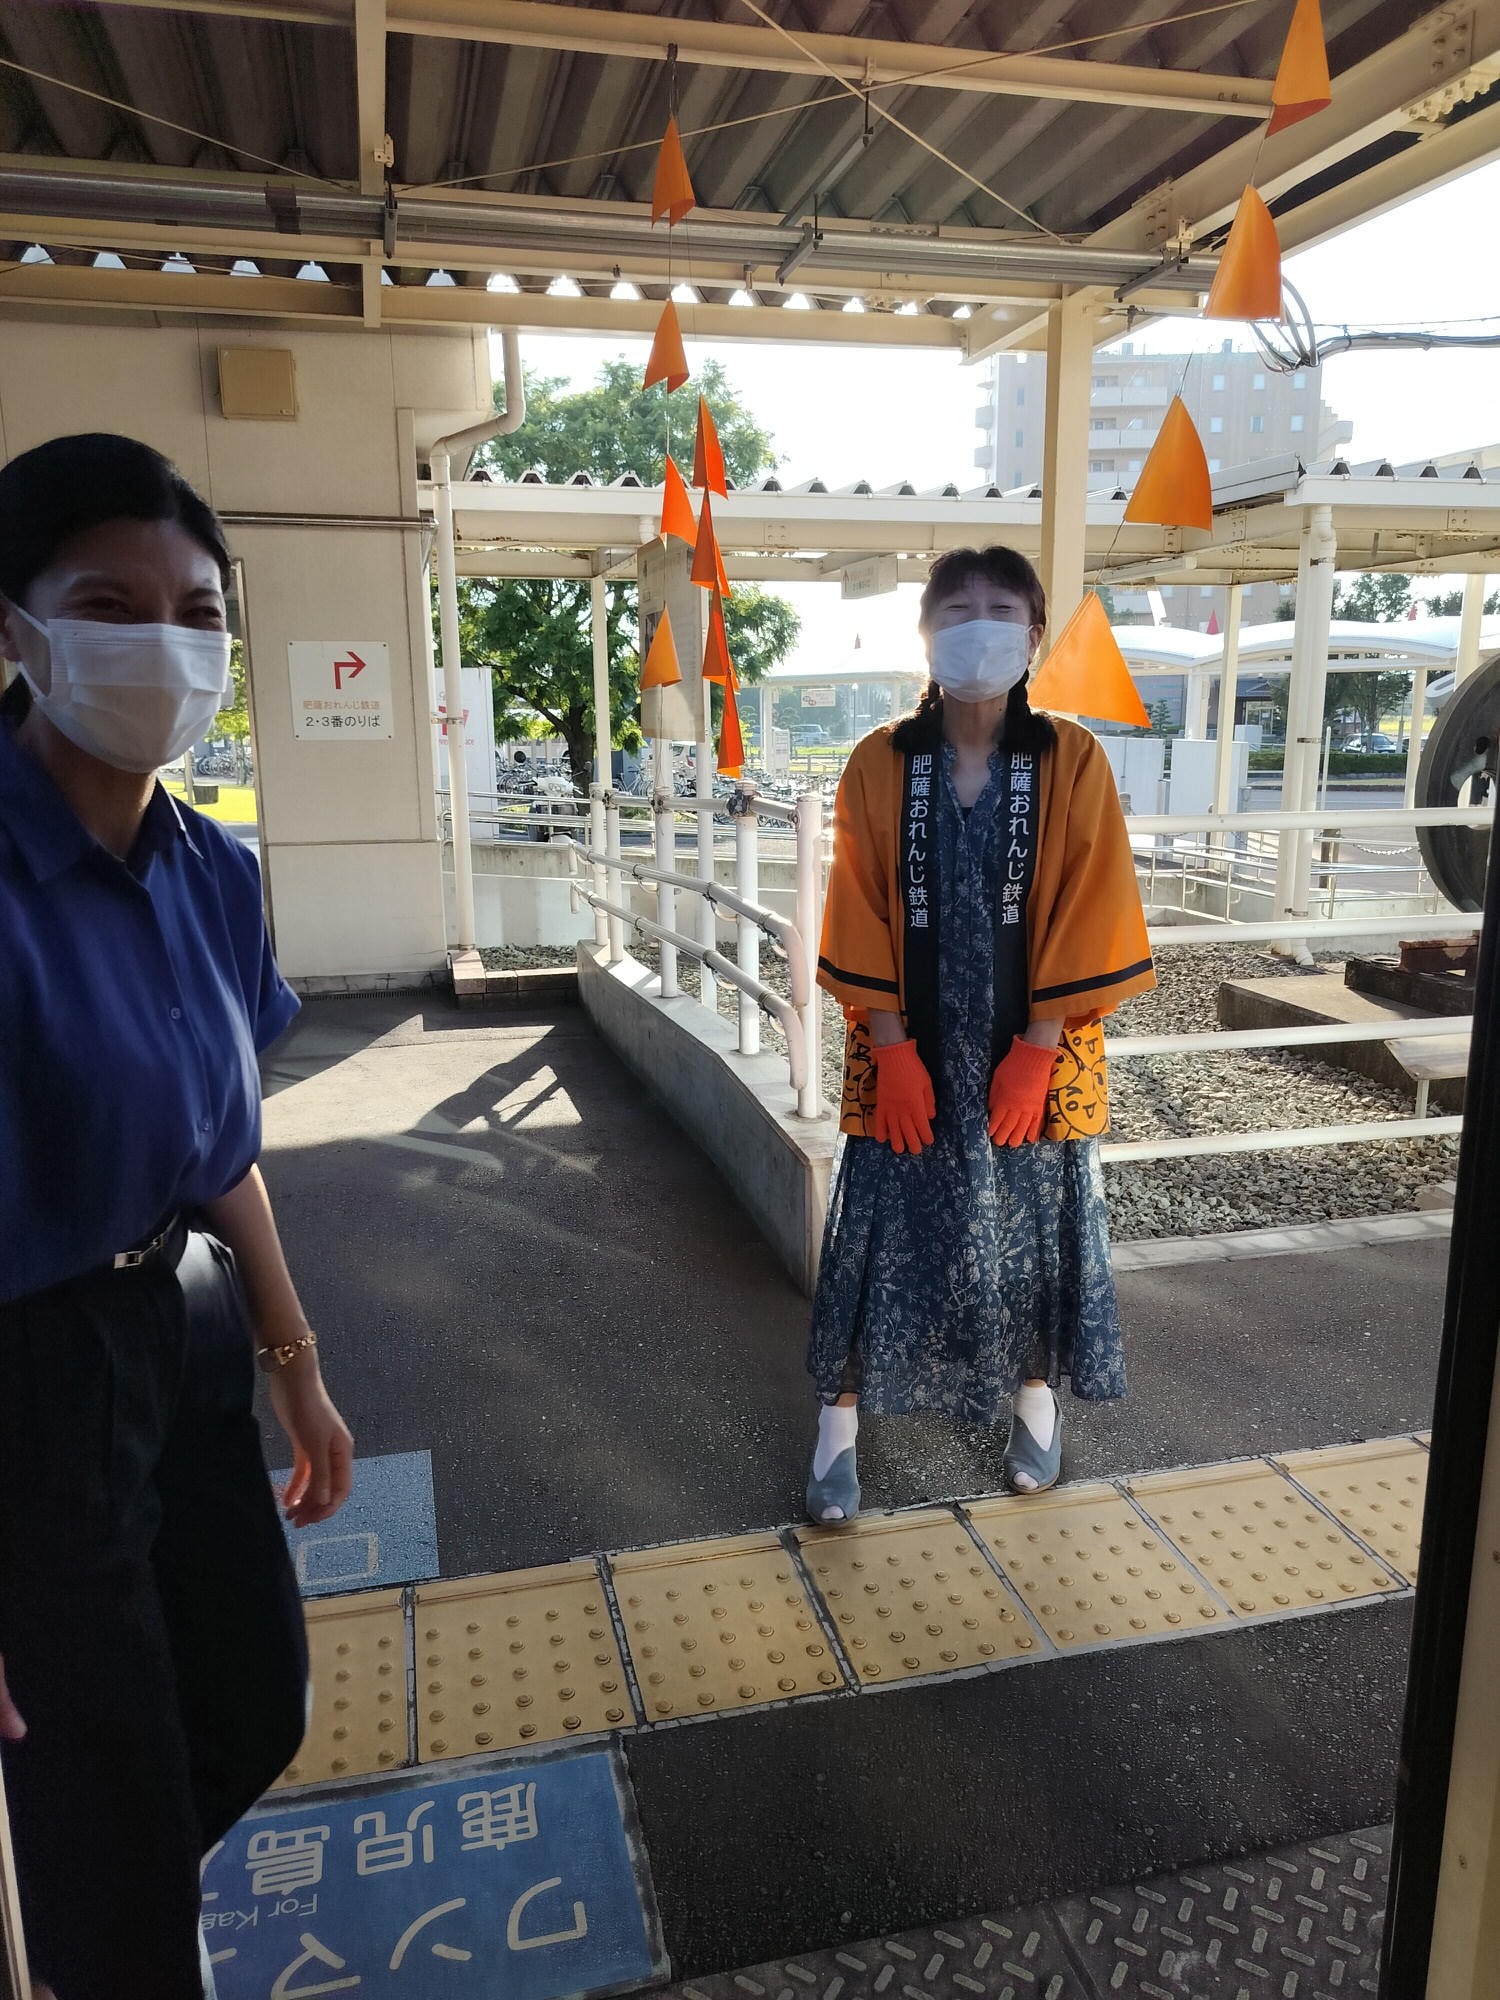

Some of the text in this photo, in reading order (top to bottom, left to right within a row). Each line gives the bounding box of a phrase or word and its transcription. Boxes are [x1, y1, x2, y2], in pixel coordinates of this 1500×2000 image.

[907, 754, 932, 928] 肥薩おれんじ鉄道
[1001, 751, 1033, 925] 肥薩おれんじ鉄道
[209, 1876, 588, 2000] ワンマ
[267, 1893, 318, 1918] For
